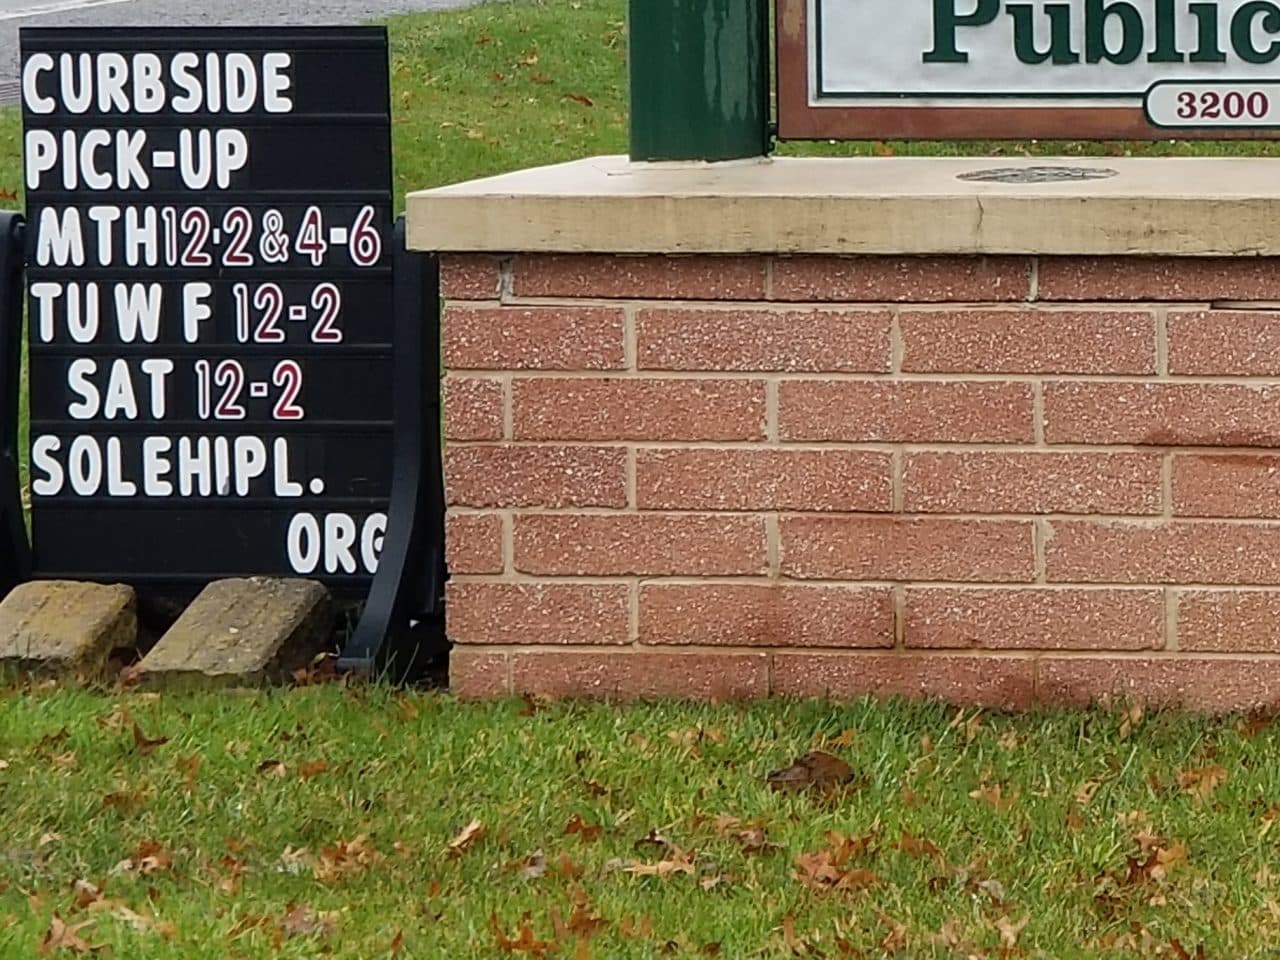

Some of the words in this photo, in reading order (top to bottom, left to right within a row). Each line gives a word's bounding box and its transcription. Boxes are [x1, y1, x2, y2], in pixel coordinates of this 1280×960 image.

[22, 52, 293, 114] CURBSIDE
[1176, 92, 1269, 119] 3200
[25, 128, 248, 190] PICK-UP
[30, 282, 99, 343] TU
[114, 282, 163, 343] W
[182, 282, 212, 343] F
[232, 282, 343, 343] 12-2
[67, 358, 174, 420] SAT
[194, 359, 305, 420] 12-2
[32, 434, 324, 497] SOLEHIPL.
[287, 512, 388, 574] ORG
